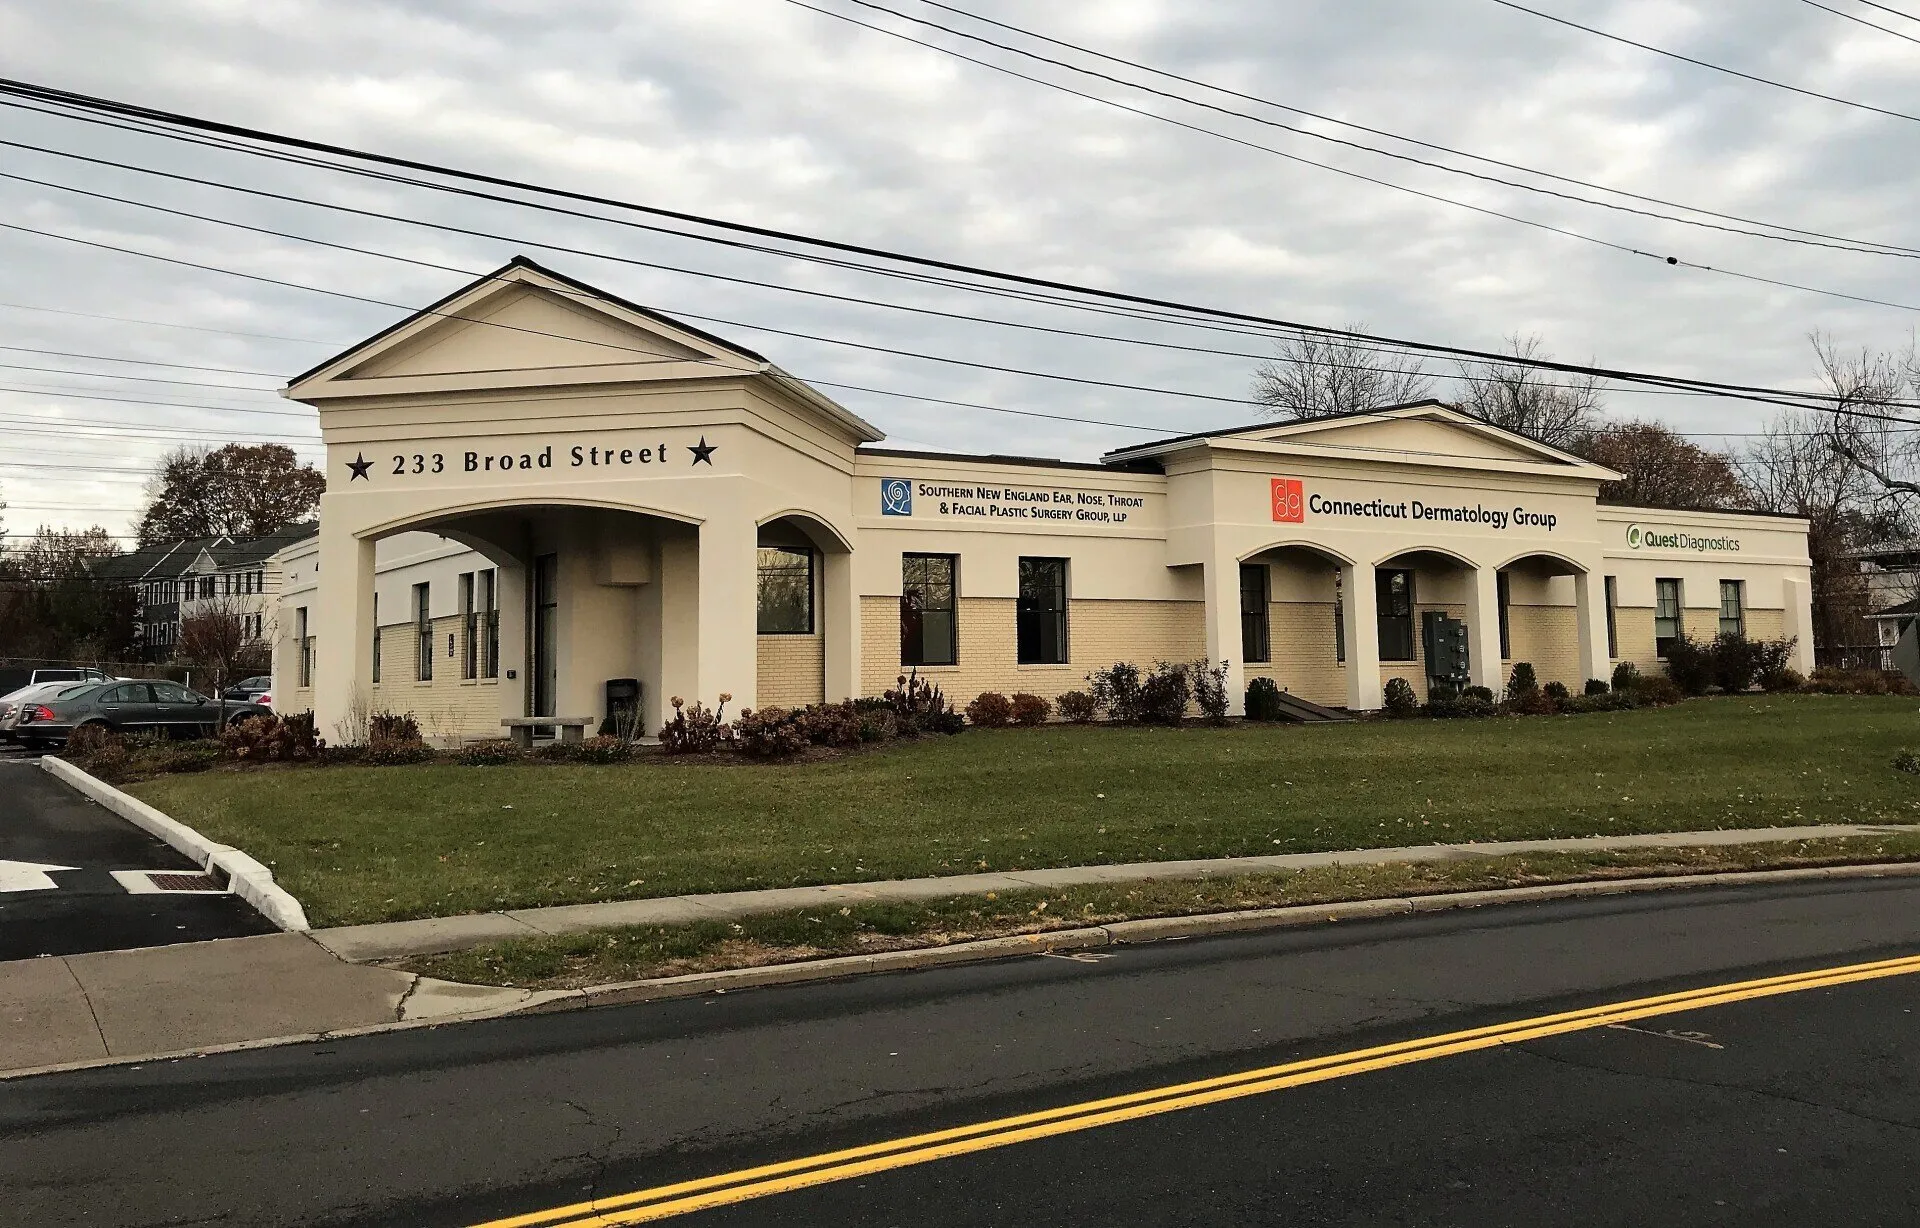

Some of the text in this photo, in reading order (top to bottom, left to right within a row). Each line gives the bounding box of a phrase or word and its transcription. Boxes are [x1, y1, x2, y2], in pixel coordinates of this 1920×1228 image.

[392, 443, 667, 475] 233 Broad Street
[919, 484, 1143, 508] SOUTHERN NEW ENGLAND EAR, NOSE, THROAT
[939, 502, 1127, 523] & FACIAL PLASTIC SURGERY GROUP, LLP
[1309, 494, 1557, 531] Connecticut Dermatology Group
